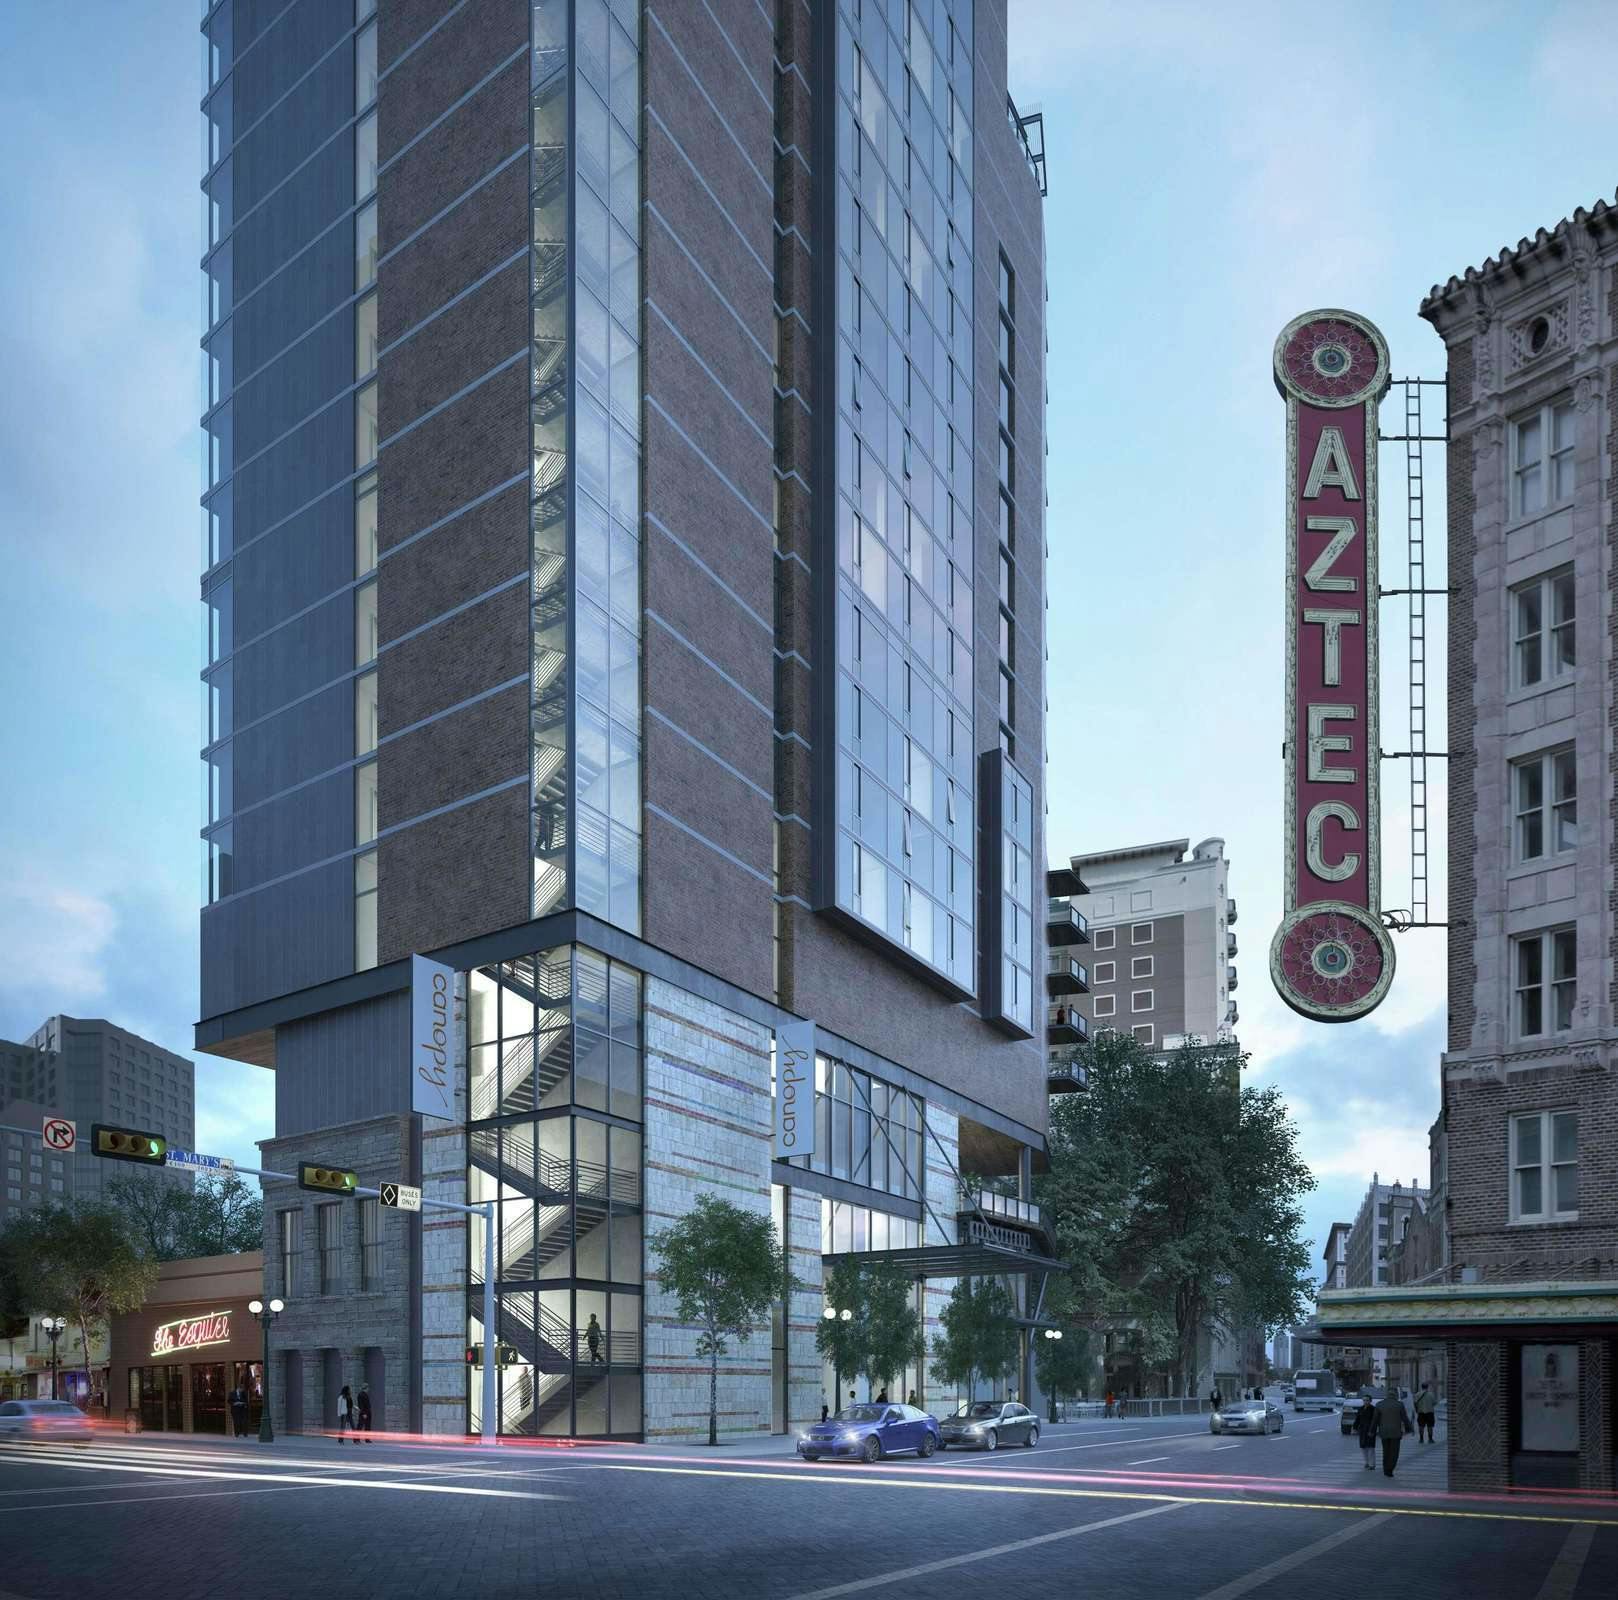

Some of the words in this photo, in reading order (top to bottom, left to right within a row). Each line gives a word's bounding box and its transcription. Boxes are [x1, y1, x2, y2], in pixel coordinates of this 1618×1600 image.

[1303, 426, 1361, 882] AZTEC
[419, 973, 448, 1108] canopy
[782, 1034, 808, 1147] canopy
[183, 1152, 219, 1169] MARY'S
[400, 1189, 419, 1199] BUSES
[402, 1198, 417, 1207] ONLY
[153, 1327, 174, 1352] The
